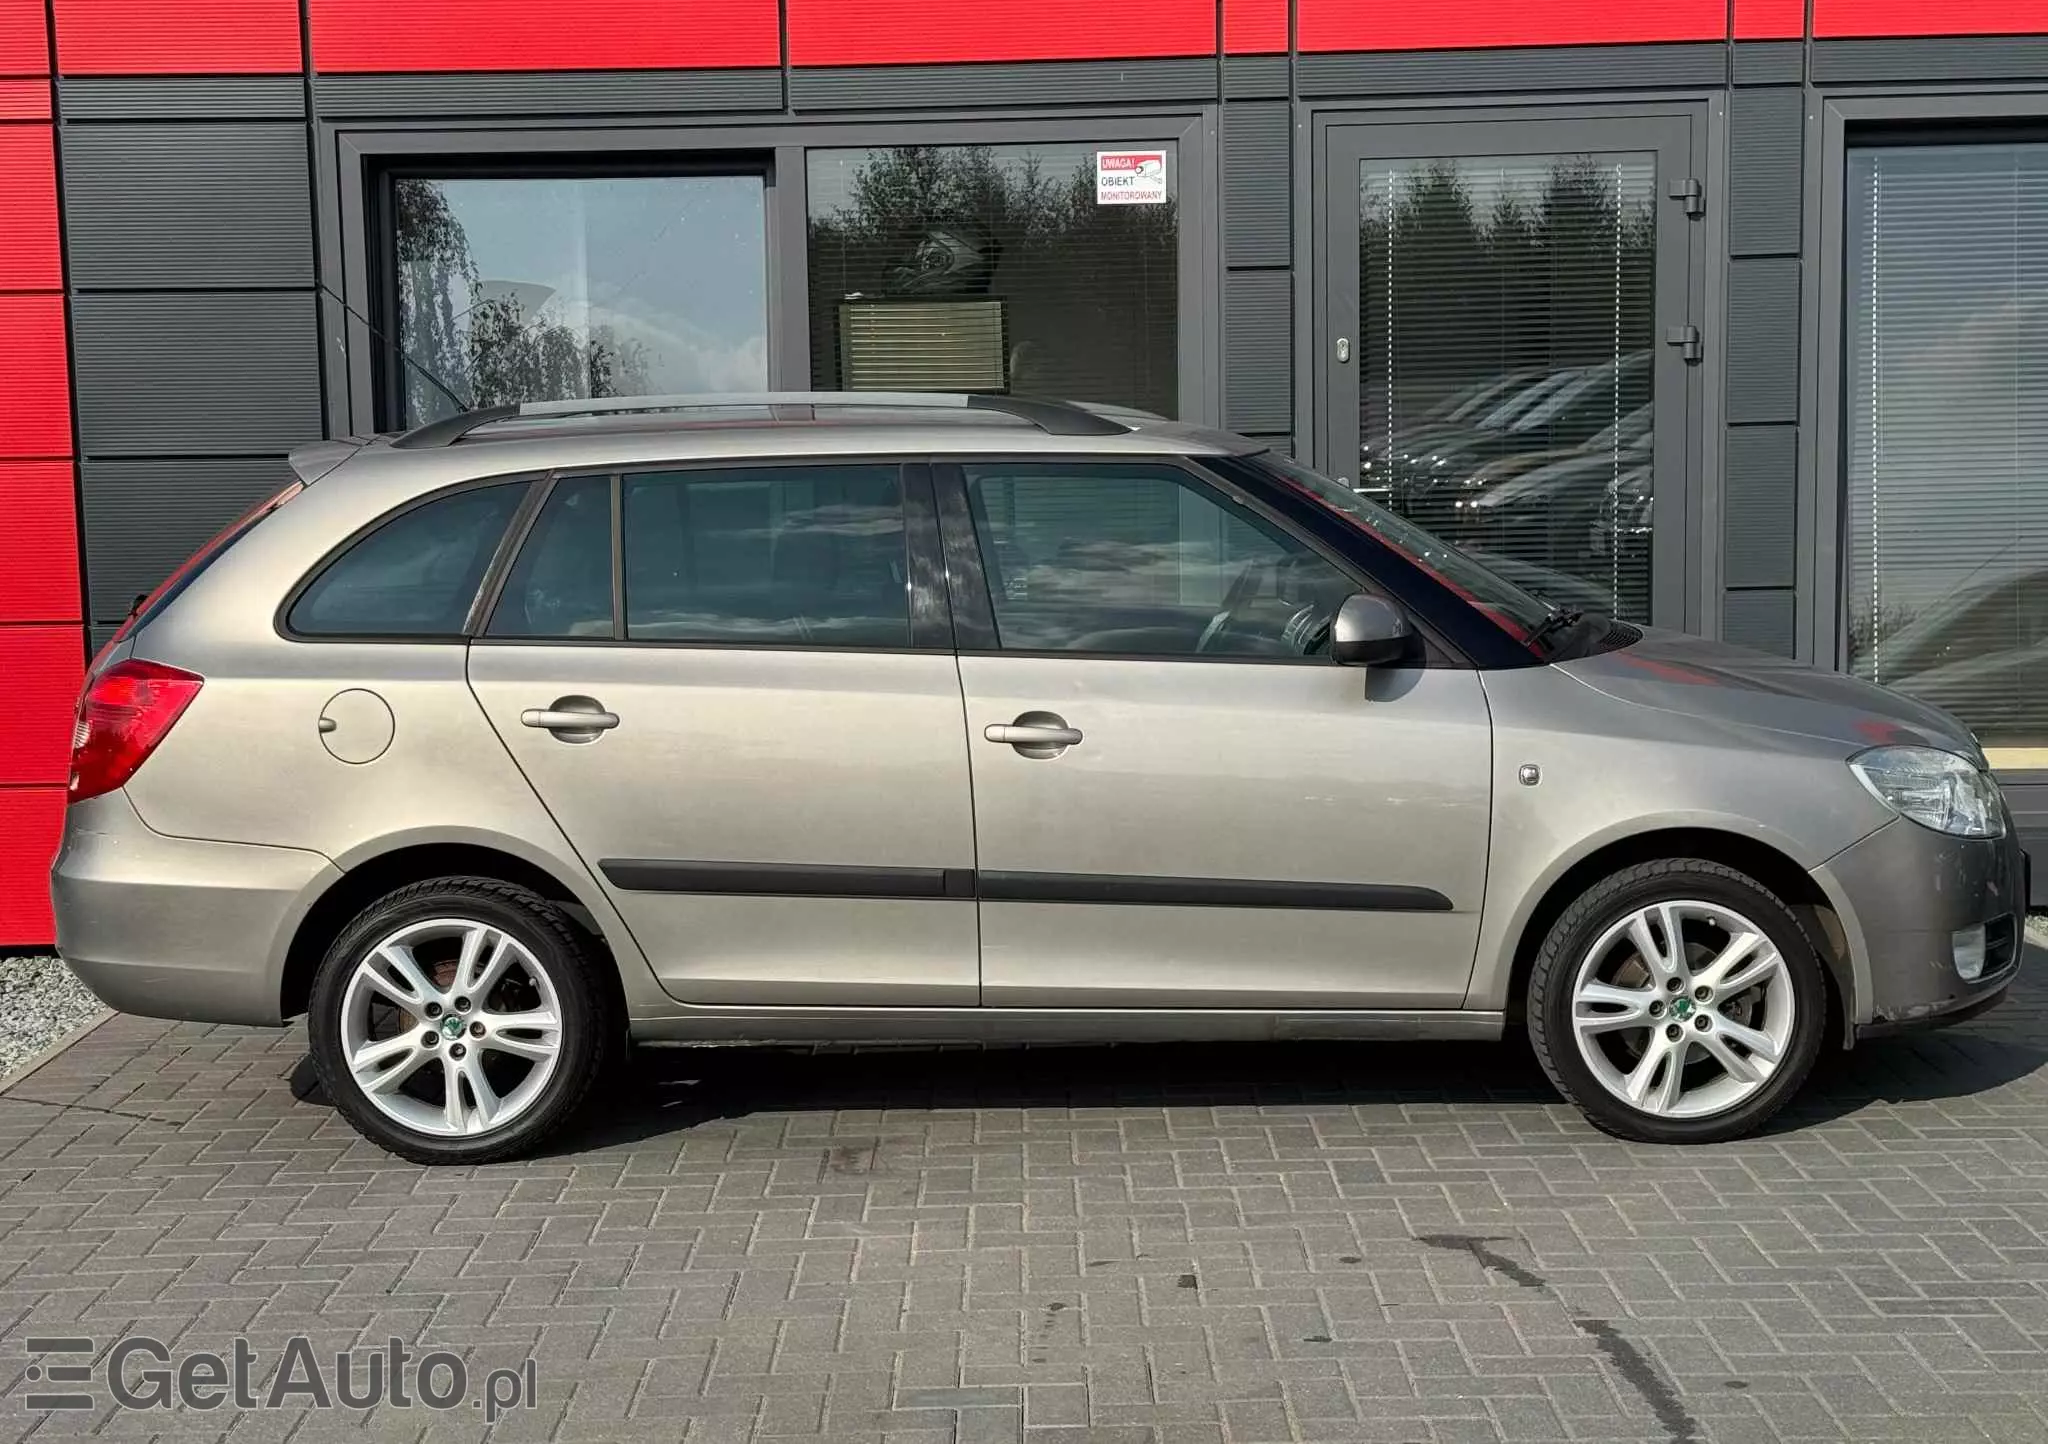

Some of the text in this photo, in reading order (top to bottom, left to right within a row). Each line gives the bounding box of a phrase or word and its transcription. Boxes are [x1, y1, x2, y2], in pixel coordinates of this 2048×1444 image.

[1102, 157, 1136, 169] UWAGA!
[1101, 176, 1135, 186] OBIEKT
[1101, 191, 1162, 200] MONITOROWANY
